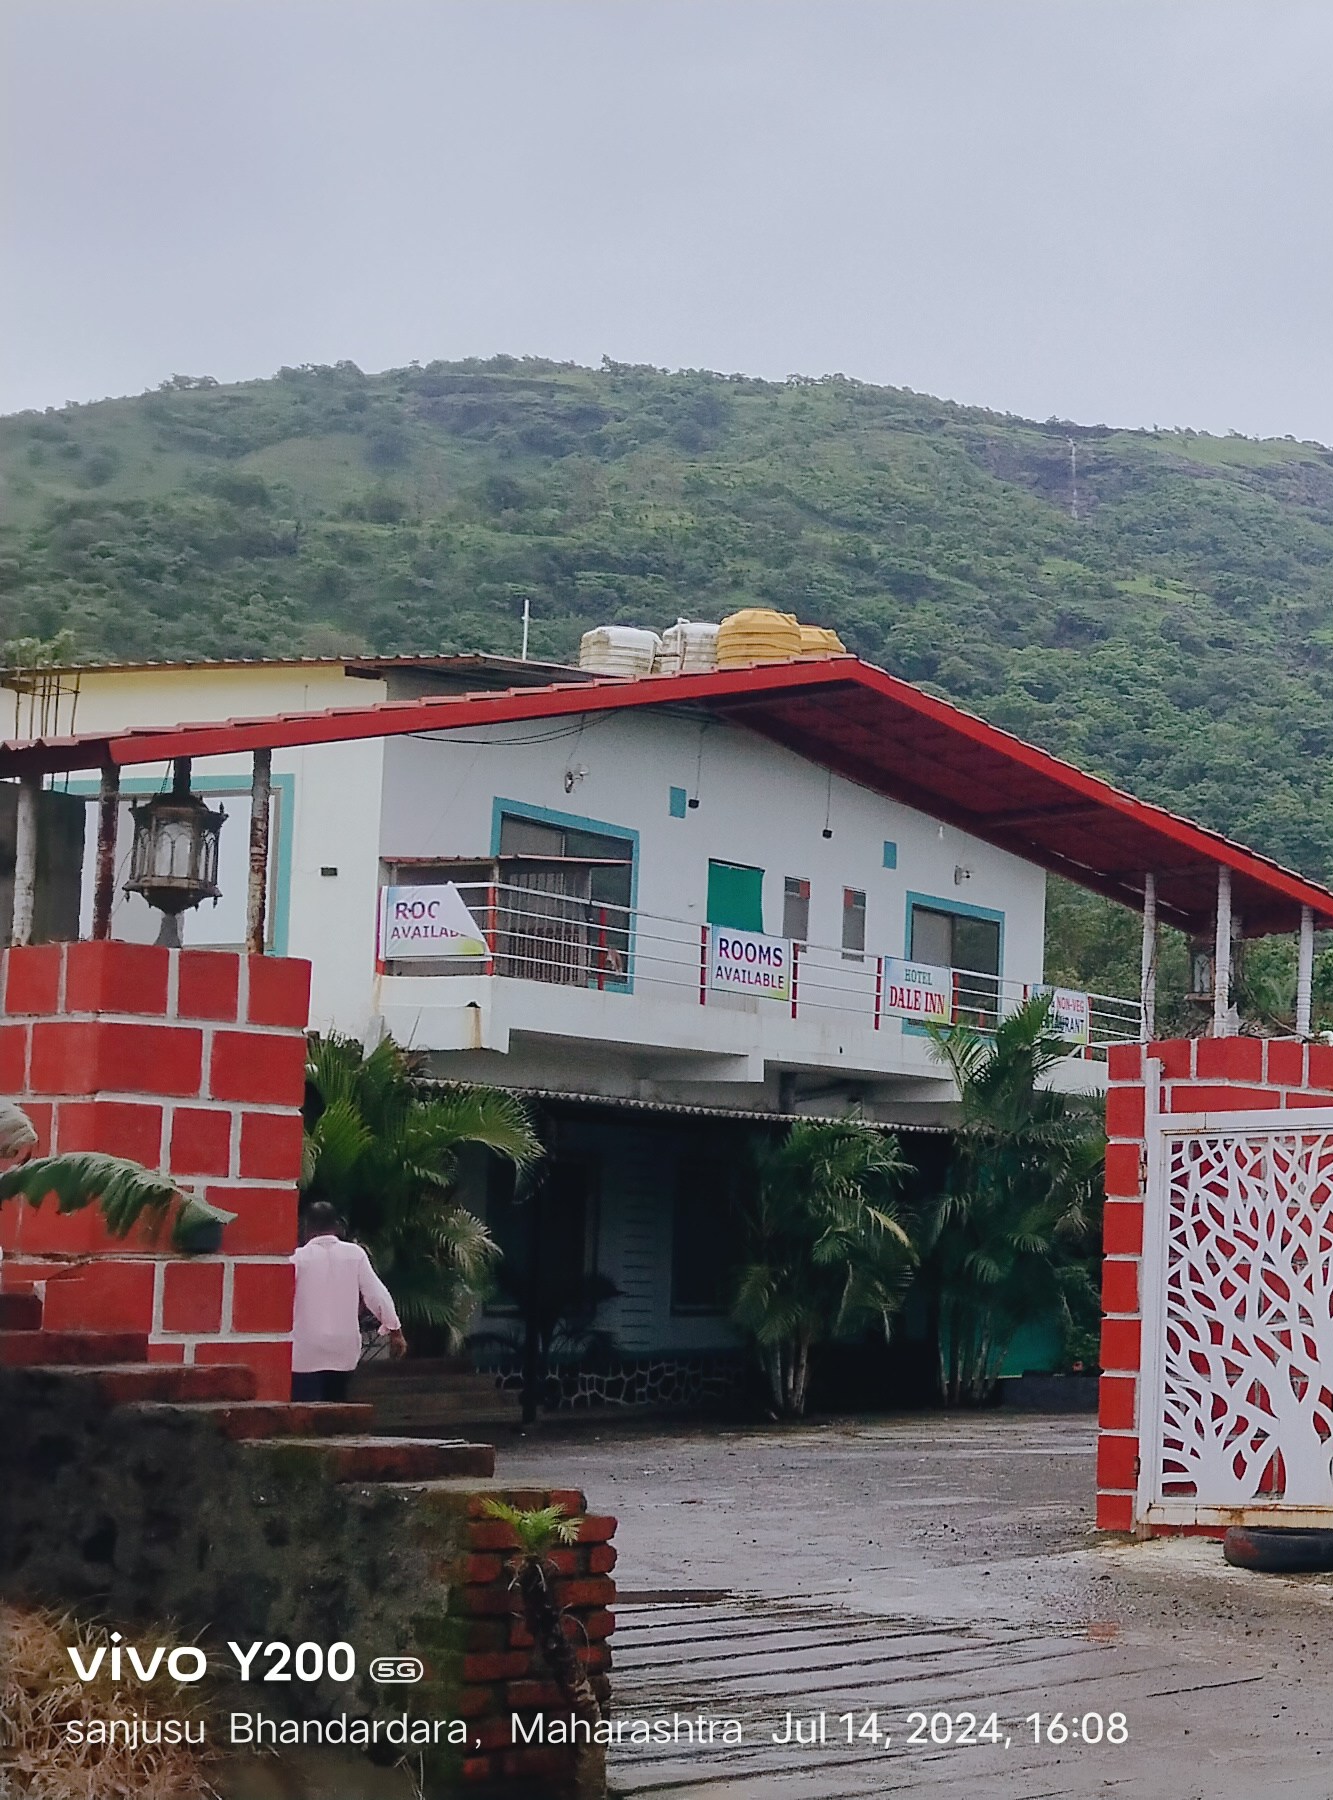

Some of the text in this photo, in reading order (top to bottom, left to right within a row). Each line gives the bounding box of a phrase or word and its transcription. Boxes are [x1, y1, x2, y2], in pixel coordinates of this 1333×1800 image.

[719, 937, 783, 967] ROOMS
[715, 965, 785, 989] AVAILABLE
[904, 968, 933, 986] HOTEL
[889, 985, 945, 1015] DALE INN
